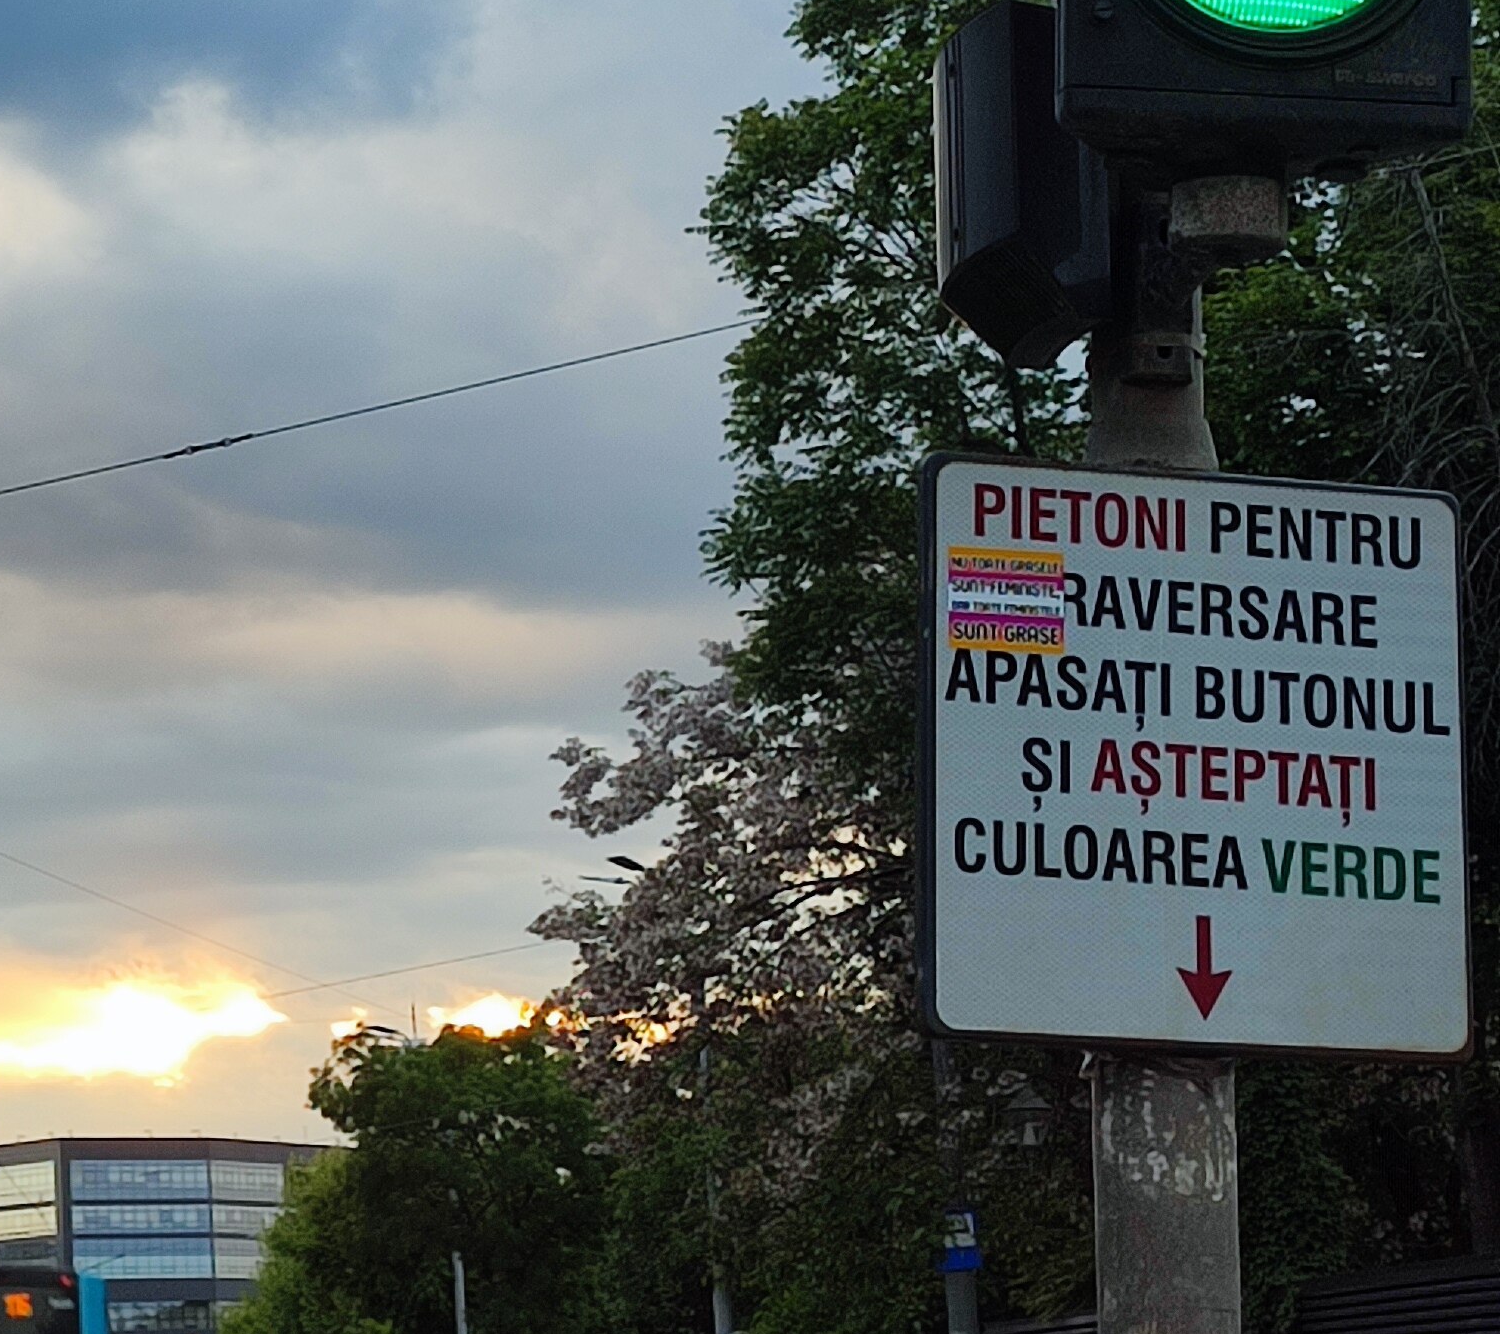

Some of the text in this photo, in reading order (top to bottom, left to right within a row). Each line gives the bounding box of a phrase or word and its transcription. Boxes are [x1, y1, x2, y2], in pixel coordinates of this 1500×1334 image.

[973, 483, 1422, 569] PIETONI PENTRU
[953, 622, 1060, 646] SUNT GRASE
[1060, 572, 1378, 648] RAVERSARE
[944, 648, 1451, 736] APASAȚI BUTONUL
[1021, 736, 1377, 828] ȘI AȘTEPTAȚI
[954, 817, 1442, 905] CULOAREA VERDE
